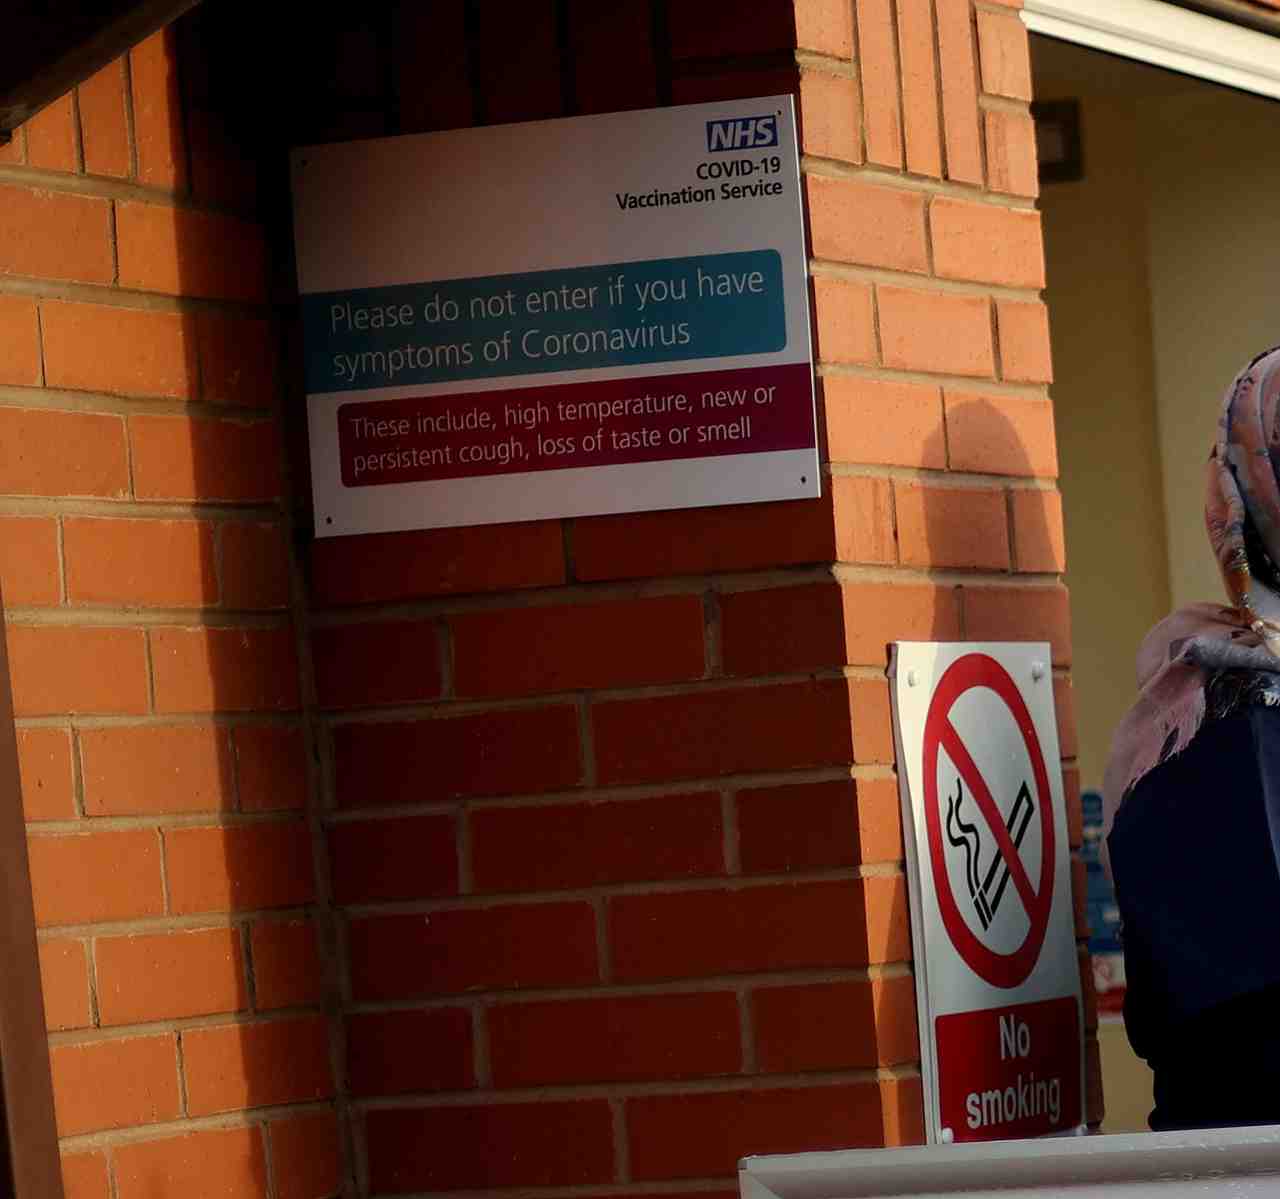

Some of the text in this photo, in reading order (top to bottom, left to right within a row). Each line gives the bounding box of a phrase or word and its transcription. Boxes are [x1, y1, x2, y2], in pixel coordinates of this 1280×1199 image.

[709, 118, 774, 150] NHS
[616, 180, 783, 210] Vaccination Service
[696, 156, 781, 180] COVID-19
[331, 264, 764, 334] Please do not enter if you have
[333, 317, 691, 381] symptoms of Coronavirus
[351, 383, 776, 439] These include, high temperature, new or
[353, 415, 752, 477] persistent cough, loss of taste or smell
[999, 1014, 1031, 1060] No
[966, 1072, 1061, 1129] smoking
